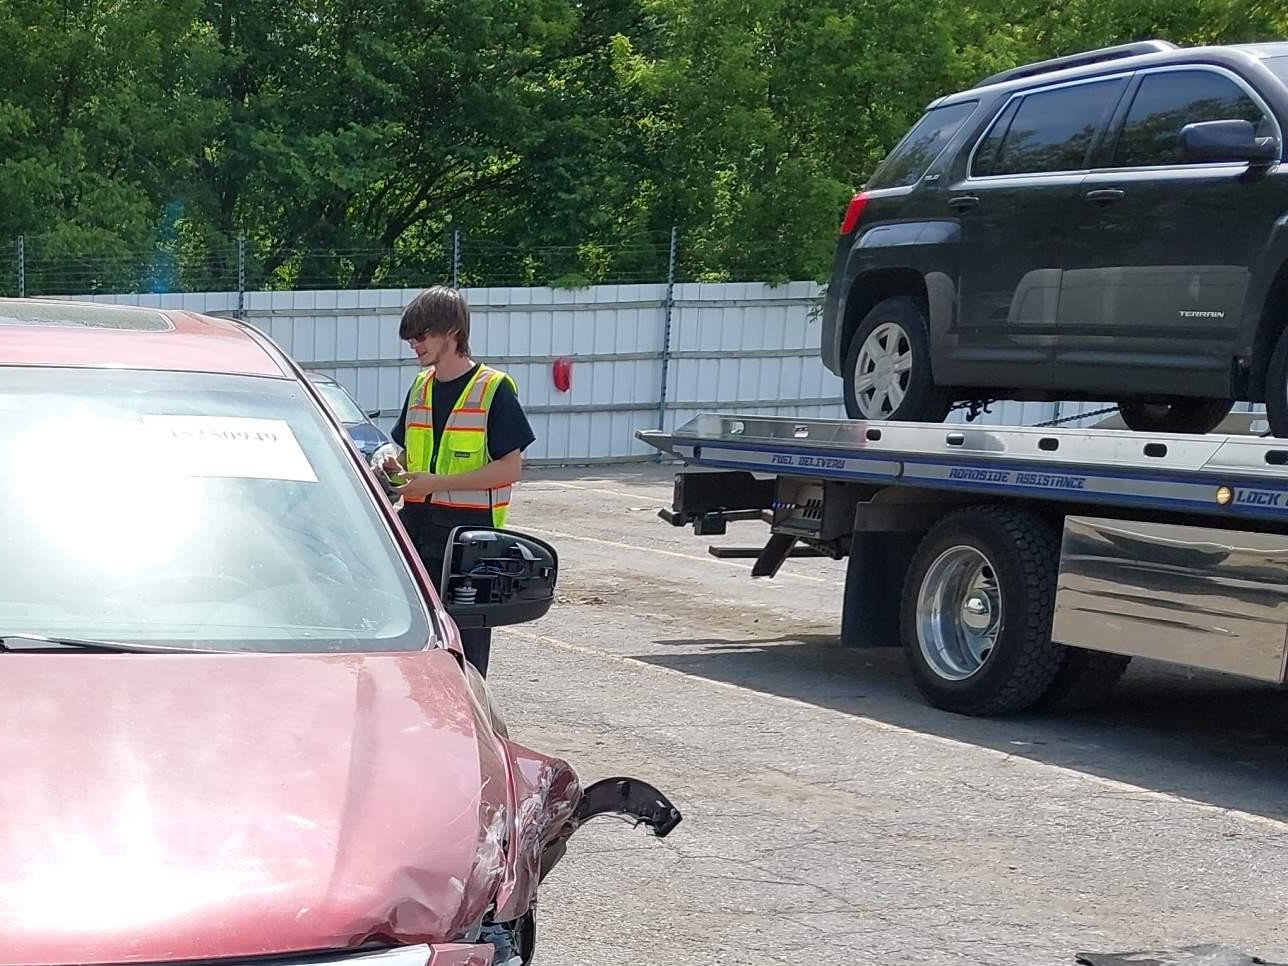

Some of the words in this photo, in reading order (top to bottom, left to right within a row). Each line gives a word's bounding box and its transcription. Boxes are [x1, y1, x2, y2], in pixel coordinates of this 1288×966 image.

[1178, 310, 1224, 318] TERRAIN
[771, 455, 795, 466] FUEL
[798, 456, 845, 469] DELIVERY
[949, 468, 1010, 483] ROADSIDE
[1015, 473, 1086, 489] ASSISTANCE
[1237, 490, 1281, 505] LOCK
